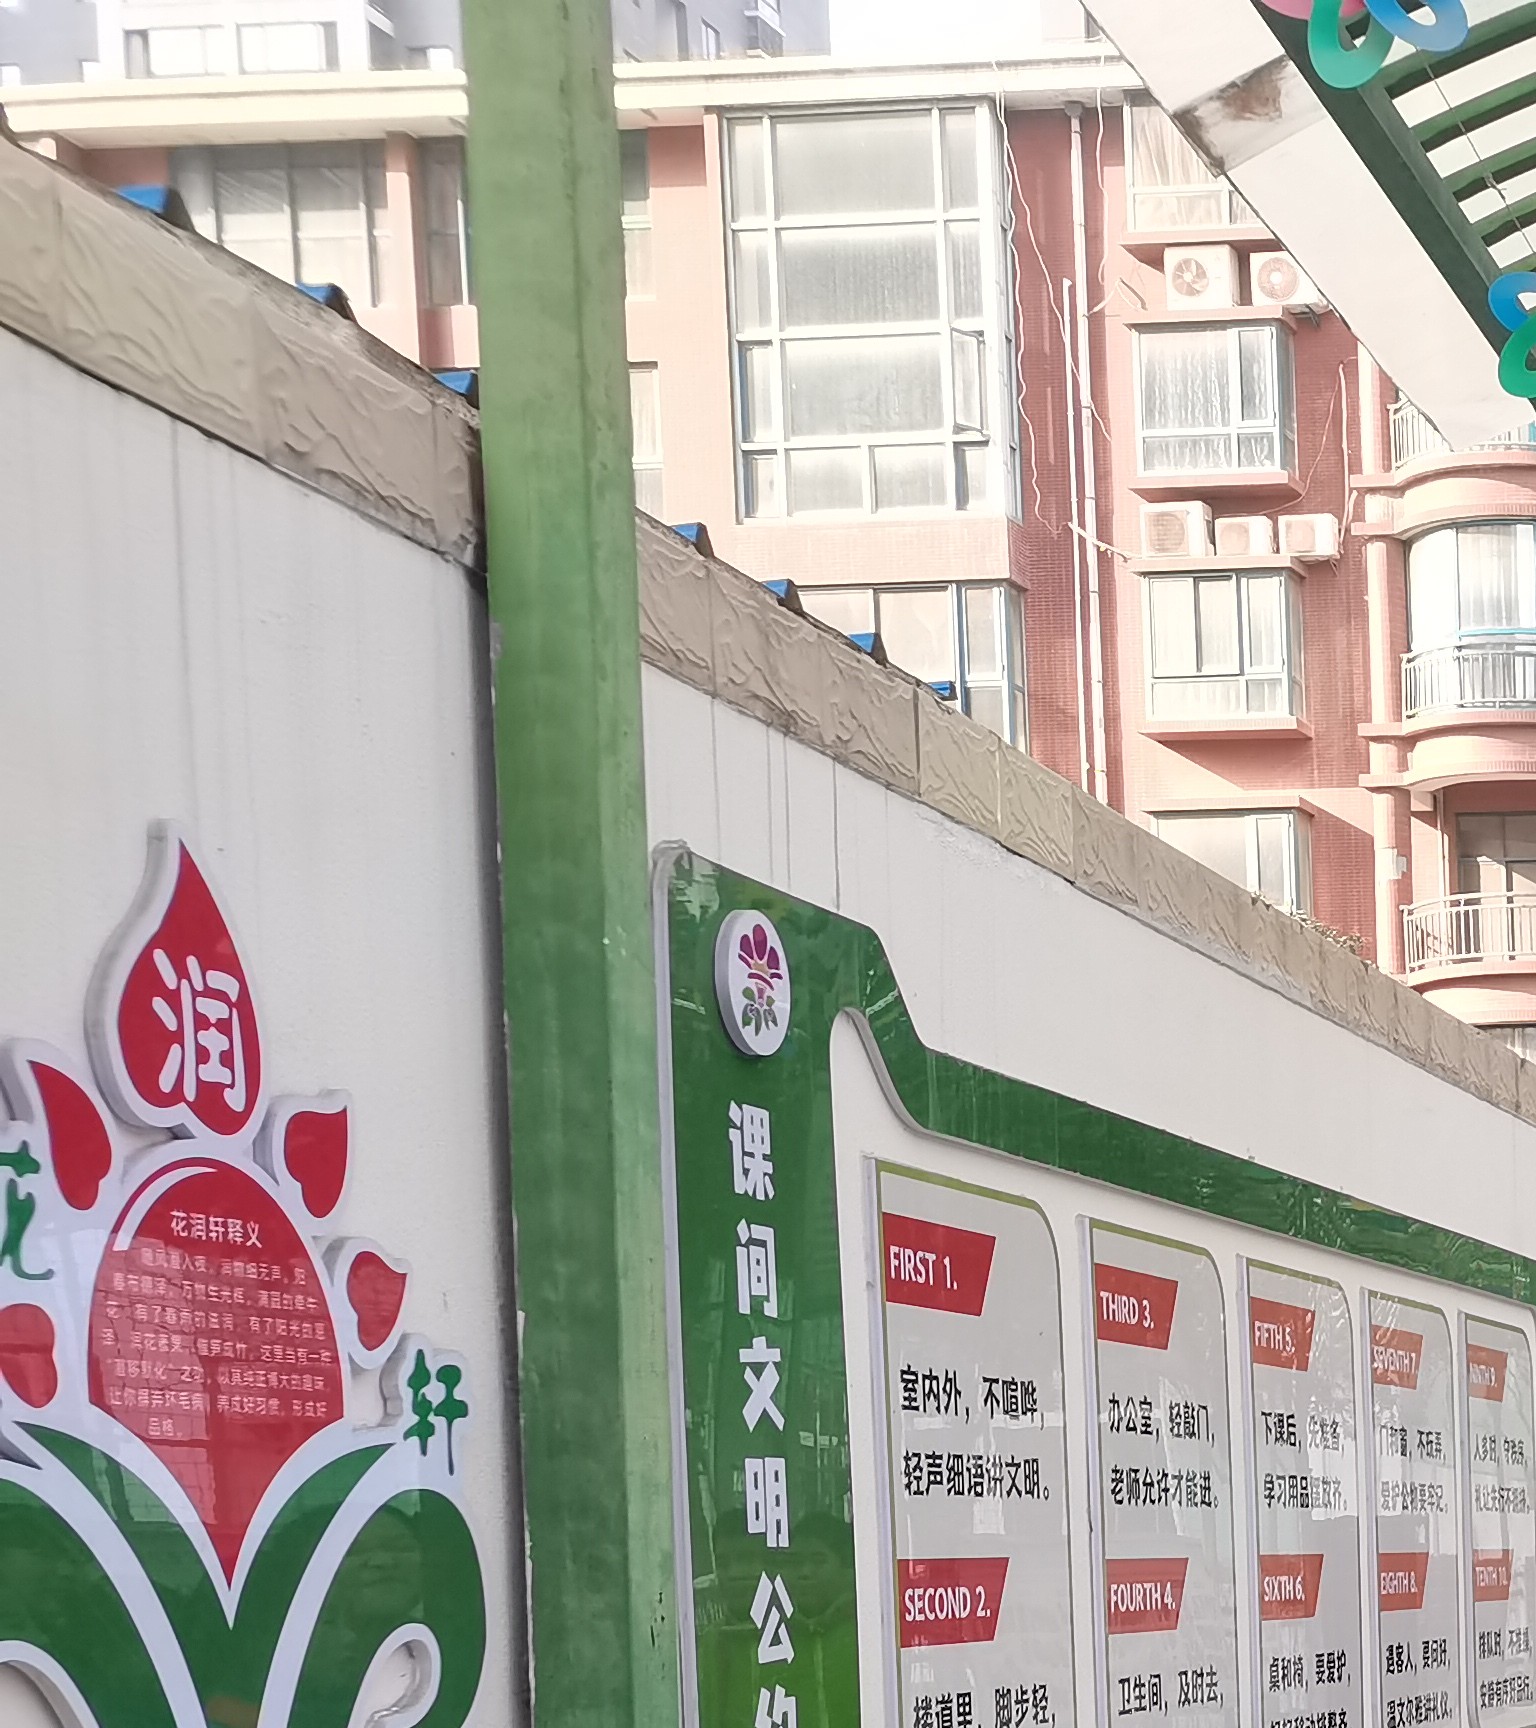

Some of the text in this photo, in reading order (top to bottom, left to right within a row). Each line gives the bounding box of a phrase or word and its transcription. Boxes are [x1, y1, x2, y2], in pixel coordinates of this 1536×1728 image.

[151, 948, 246, 1113] 润
[889, 1246, 959, 1290] FIRST 1.
[1100, 1292, 1154, 1329] THIRD 3.
[1255, 1321, 1295, 1353] FIFTH 5.
[1372, 1344, 1410, 1373] SEVENTH
[900, 1363, 1046, 1431] 室内外，不喧哗，
[1108, 1392, 1215, 1447] 办公室，轻敲门，
[903, 1451, 1050, 1501] 轻声细语讲文明。
[1110, 1464, 1219, 1509] 老师允许才能进。
[1264, 1576, 1305, 1602] SIXTH 6.
[1381, 1571, 1417, 1595] EIGHTH 8.
[1476, 1566, 1497, 1587] TENTH
[904, 1584, 991, 1622] SECOND 2.
[1110, 1582, 1176, 1612] FOURTH 4.
[1269, 1649, 1350, 1693] 桌和椅，要爱护，
[1386, 1638, 1450, 1676] 遇客人，要问好，
[1118, 1665, 1224, 1717] 卫生间，及时去，
